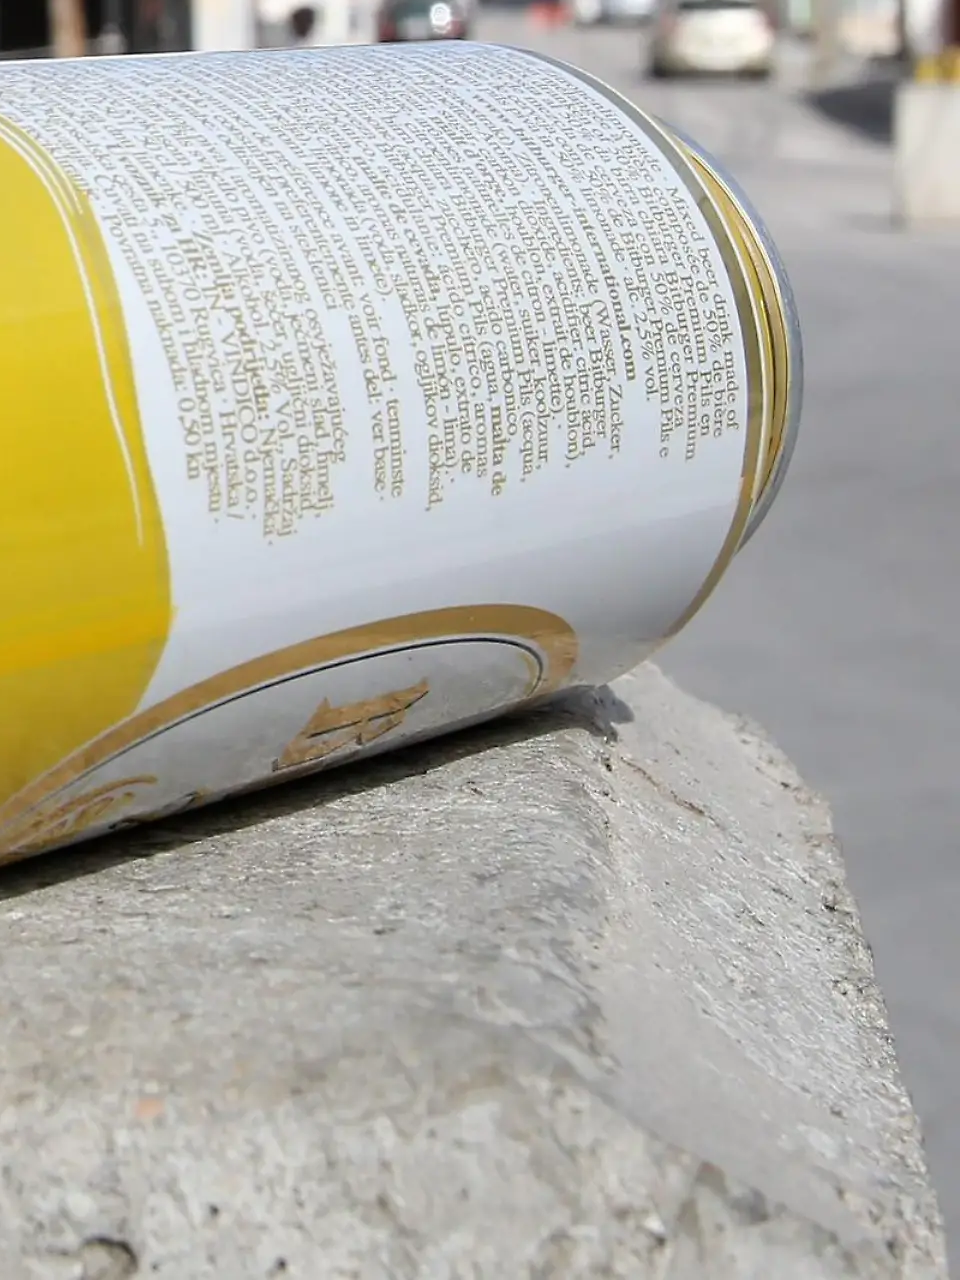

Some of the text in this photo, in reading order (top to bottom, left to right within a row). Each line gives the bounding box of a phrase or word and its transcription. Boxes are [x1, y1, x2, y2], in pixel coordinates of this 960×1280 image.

[347, 313, 372, 364] antes
[540, 283, 570, 342] extrait
[649, 270, 675, 316] 50%
[670, 350, 684, 428] cerveza
[679, 274, 708, 364] Premium
[699, 369, 713, 407] Pils
[702, 307, 723, 353] 50%
[711, 292, 734, 343] drink
[723, 350, 739, 403] made
[220, 330, 261, 444] VINDICO
[413, 349, 440, 429] ogljikov
[453, 375, 473, 446] extrato
[467, 299, 488, 336] Pils
[489, 405, 506, 466] malta
[517, 367, 534, 407] Pils
[575, 355, 593, 405] citric
[578, 302, 597, 344] beer
[589, 347, 608, 439] Bitburger
[650, 317, 672, 405] Premium
[661, 407, 675, 442] Pils
[663, 270, 694, 364] Bitburger
[685, 369, 700, 460] Premium
[180, 339, 214, 436] hladnom
[201, 440, 223, 513] mjestu
[218, 408, 242, 508] Hrvatska
[370, 410, 384, 444] ver
[371, 334, 397, 382] fond
[385, 397, 406, 498] tenminste
[473, 401, 487, 479] aromas
[374, 445, 390, 492] base
